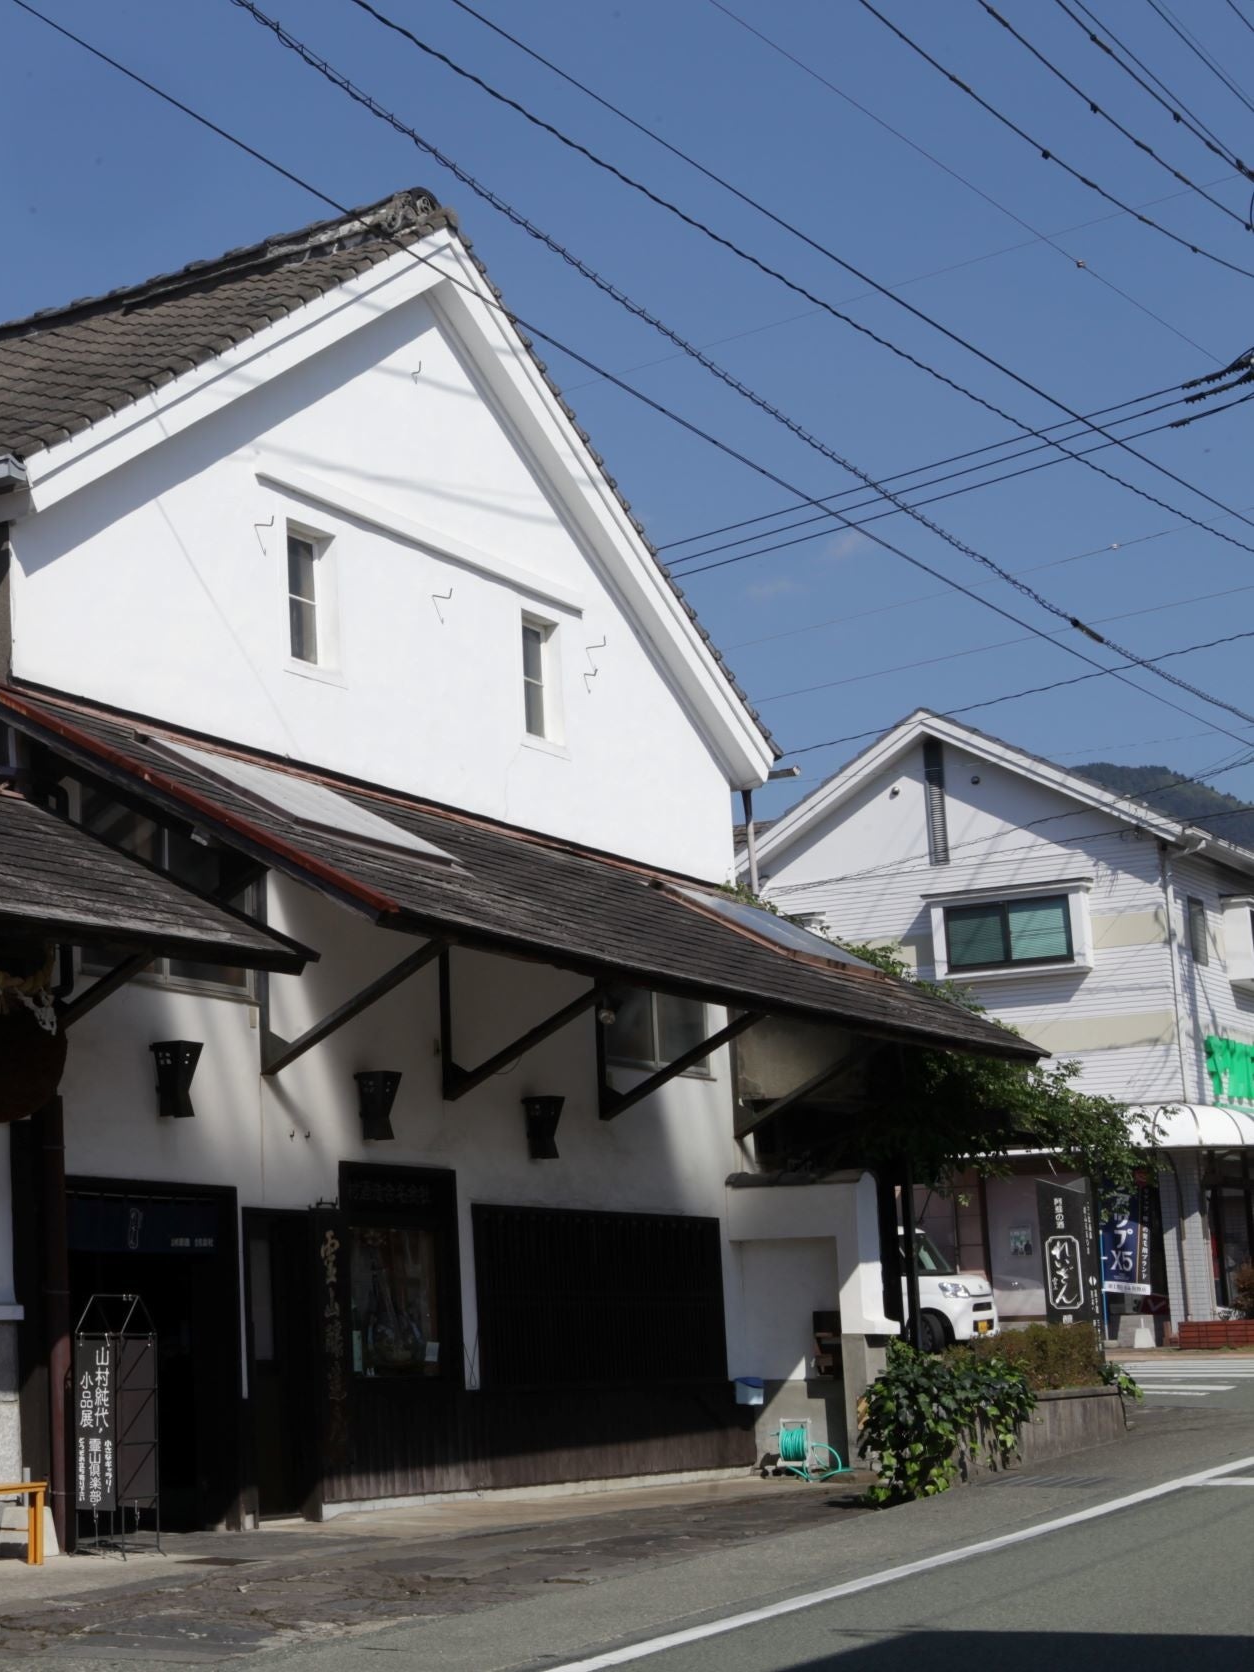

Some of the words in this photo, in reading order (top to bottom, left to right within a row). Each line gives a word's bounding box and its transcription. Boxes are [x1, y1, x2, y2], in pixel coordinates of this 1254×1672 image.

[1053, 1197, 1065, 1230] 阿蘇の酒
[1051, 1239, 1078, 1304] れいざん
[79, 1371, 94, 1428] 小品展
[88, 1438, 102, 1503] 霊山倶楽部
